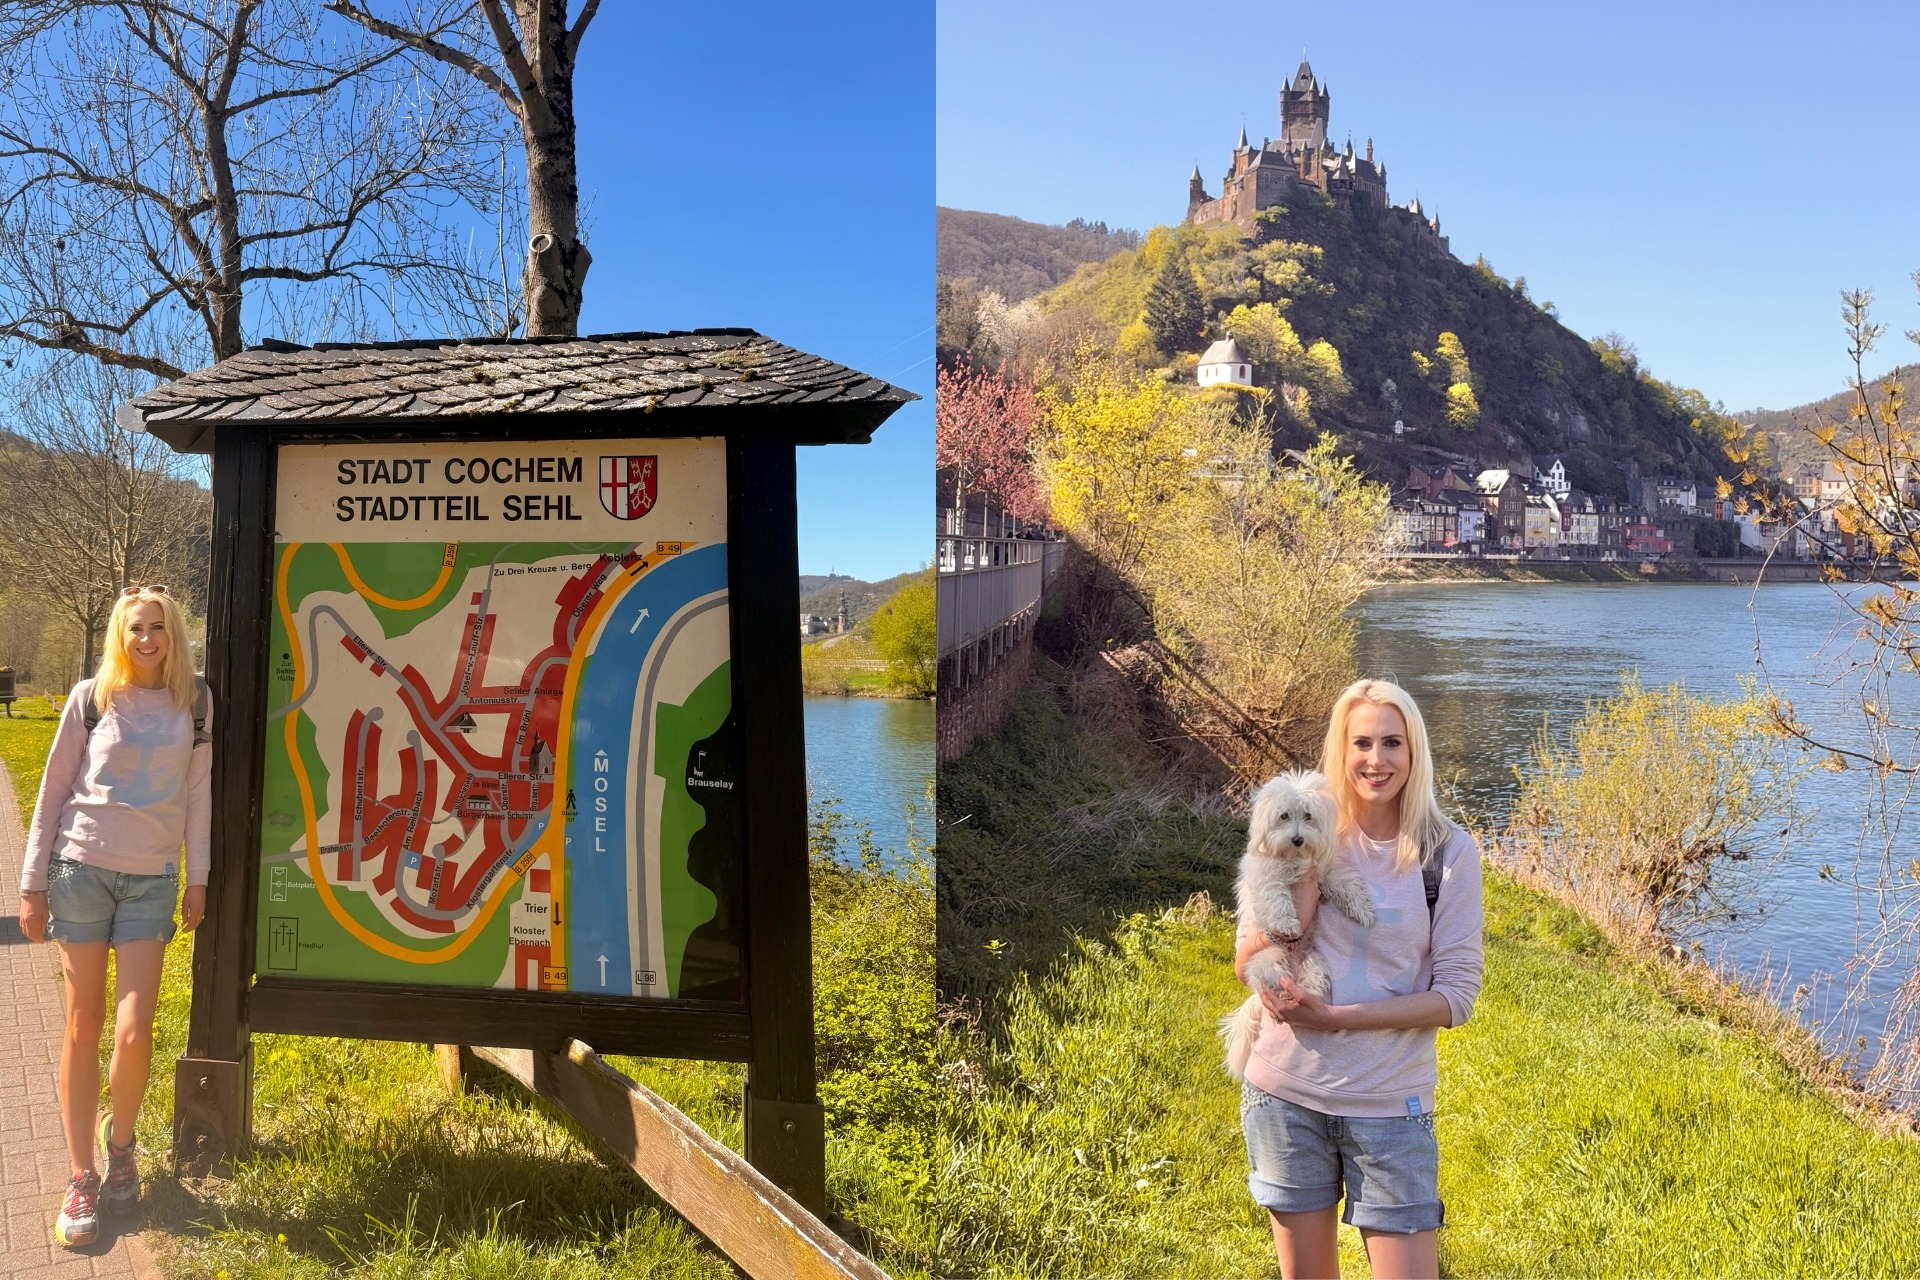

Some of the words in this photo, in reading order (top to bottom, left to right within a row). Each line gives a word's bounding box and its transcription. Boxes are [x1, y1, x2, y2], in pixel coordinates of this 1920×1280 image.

[337, 459, 431, 484] STADT
[444, 457, 582, 484] COCHEM
[336, 496, 489, 522] STADTTEIL
[503, 495, 582, 521] SEHL
[448, 545, 456, 558] 259
[600, 553, 642, 562] Koblenz
[494, 568, 504, 576] Zu
[508, 566, 525, 575] Drei
[528, 565, 557, 574] Kreuze
[572, 562, 592, 572] Berg
[573, 592, 594, 618] Oberer
[591, 574, 608, 592] Weg
[353, 636, 374, 657] Ellerer
[374, 656, 388, 670] Str.
[461, 616, 484, 696] Josef-v.-Lauff-Str.
[534, 688, 564, 696] Anlage
[469, 696, 520, 704] Antoniusstr.
[520, 710, 532, 732] Brühl
[516, 734, 525, 745] Im
[498, 772, 526, 780] Ellerer
[530, 773, 545, 781] Str.
[482, 780, 500, 788] Winkel
[688, 777, 734, 790] Brauselay
[354, 766, 364, 820] Schubertstr.
[594, 758, 608, 852] MOSEL
[457, 810, 505, 820] Bürgerhaus
[507, 811, 536, 820] Schulstr.
[402, 834, 412, 850] Am
[566, 838, 572, 846] P
[320, 844, 354, 854] Brahmsstr.
[410, 856, 417, 864] P
[515, 865, 522, 874] B
[521, 854, 533, 866] 259
[429, 864, 442, 904] Mozartstr.
[466, 848, 515, 909] Klostergartenstr.
[288, 882, 316, 890] Bolzplatz
[524, 902, 548, 914] Trier
[514, 926, 546, 936] Kloster
[509, 938, 550, 946] Ebernach
[554, 972, 566, 980] 49
[644, 974, 655, 982] 98
